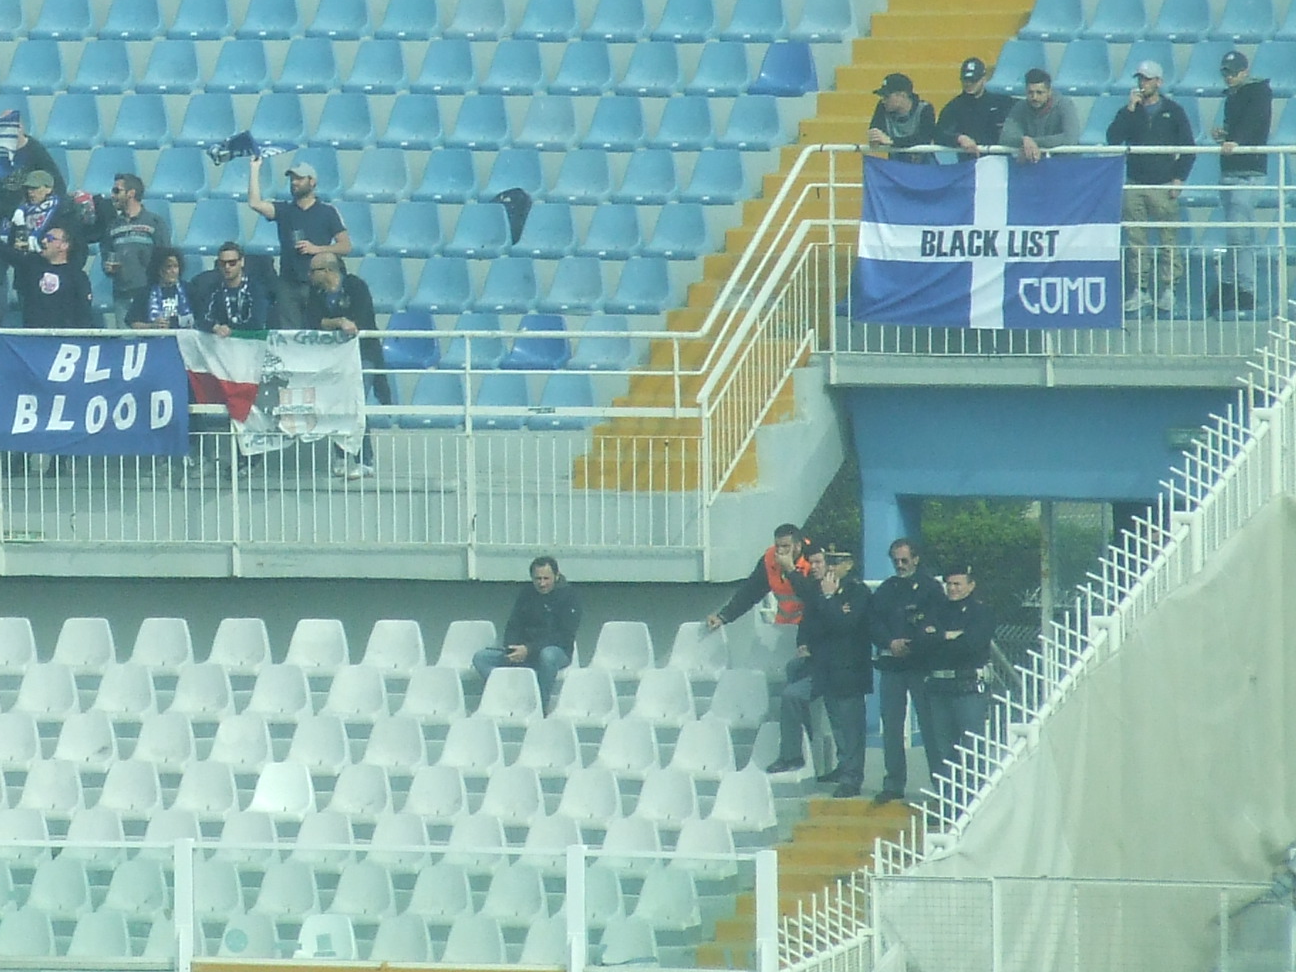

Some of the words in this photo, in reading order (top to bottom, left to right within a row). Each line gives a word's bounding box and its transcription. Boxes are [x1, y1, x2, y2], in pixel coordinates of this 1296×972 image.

[921, 229, 999, 258] BLACK
[1007, 230, 1060, 258] LIST
[1018, 277, 1106, 315] COMO
[47, 342, 148, 383] BLU
[11, 390, 174, 435] BLOOD
